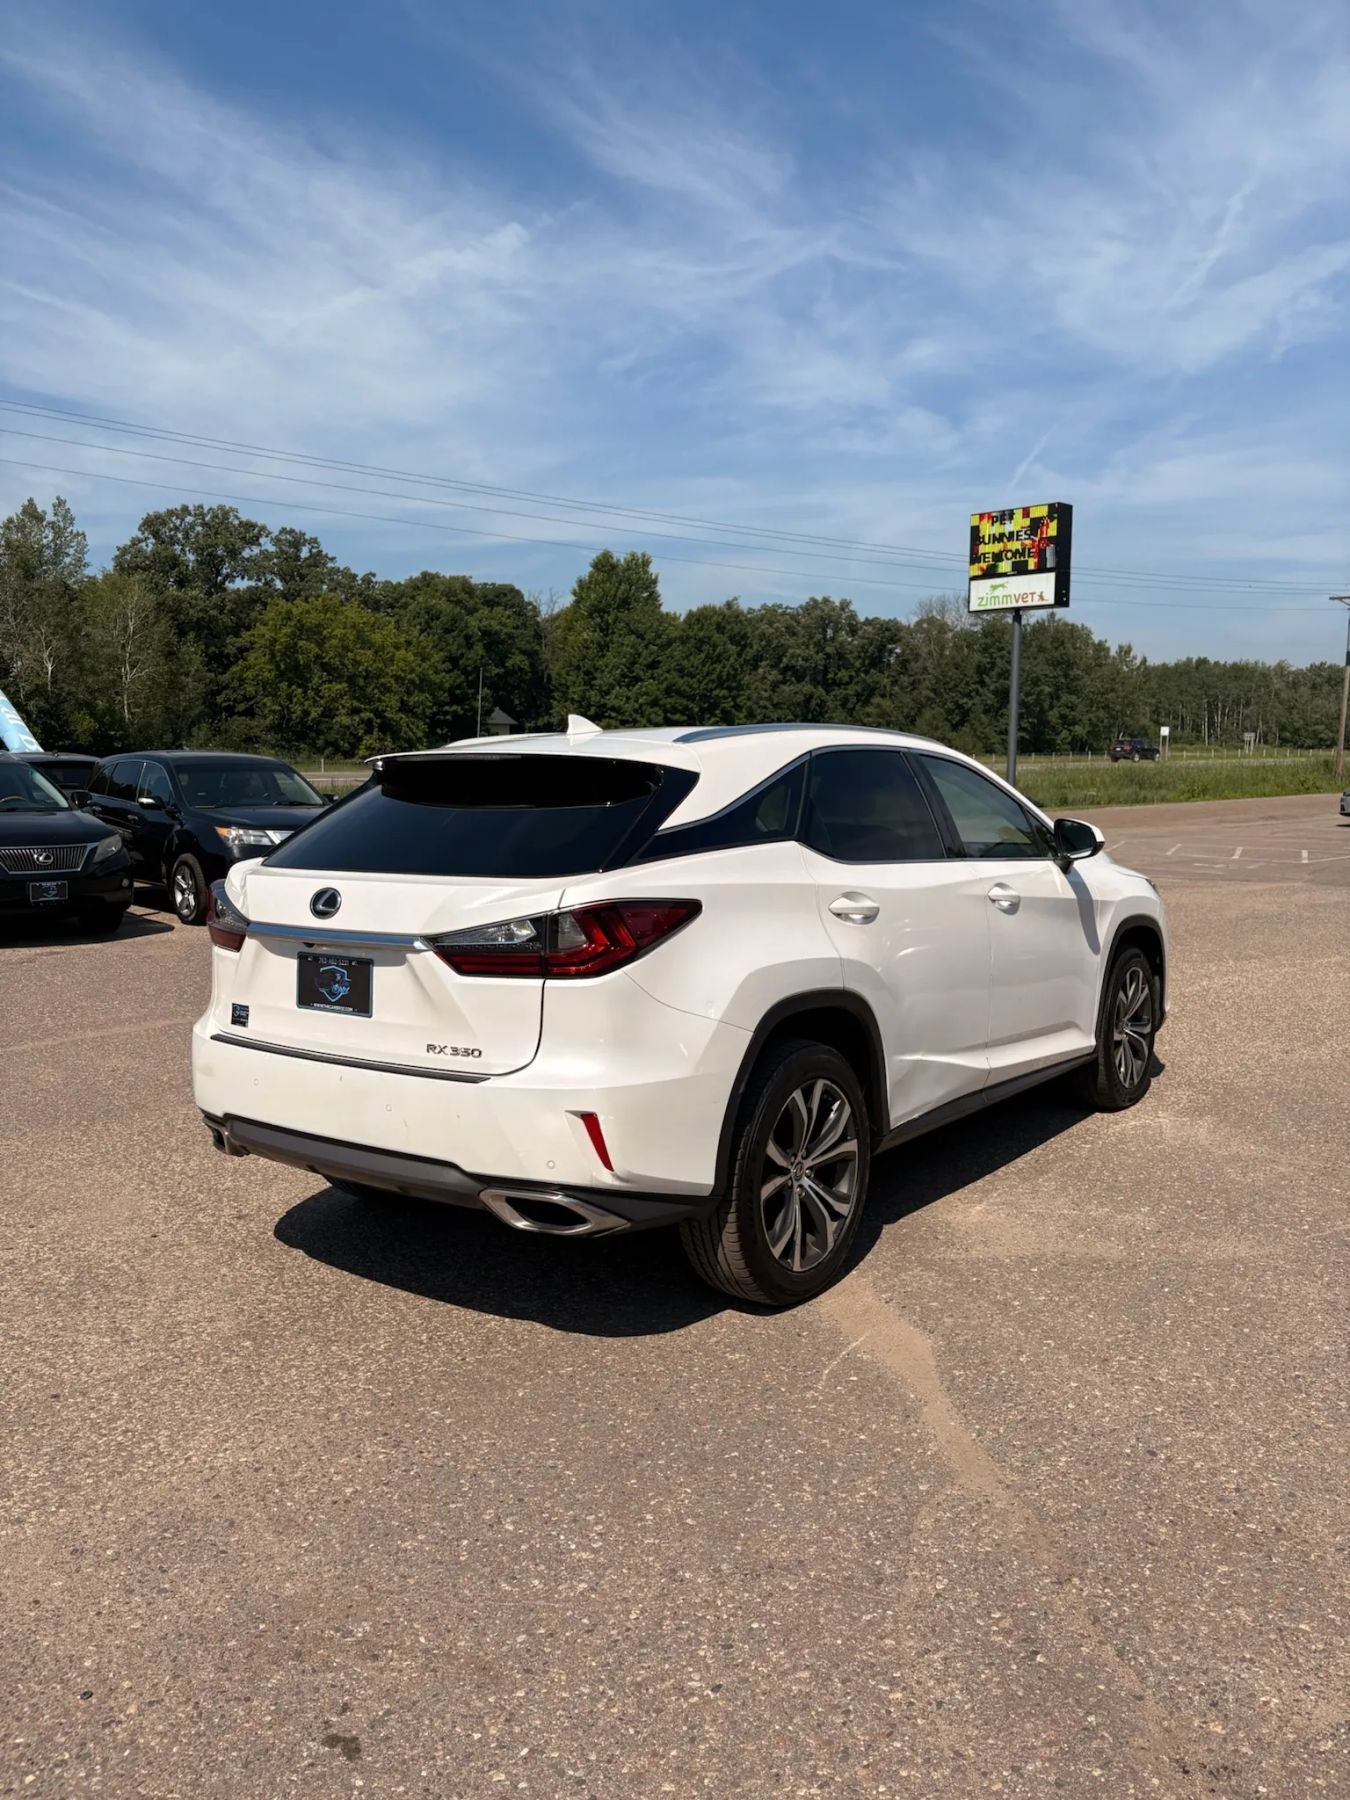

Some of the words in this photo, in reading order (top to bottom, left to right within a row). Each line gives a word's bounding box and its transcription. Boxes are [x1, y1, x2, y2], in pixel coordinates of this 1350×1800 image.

[970, 547, 1035, 565] EOME
[426, 1043, 448, 1056] RX
[449, 1046, 482, 1059] 350
